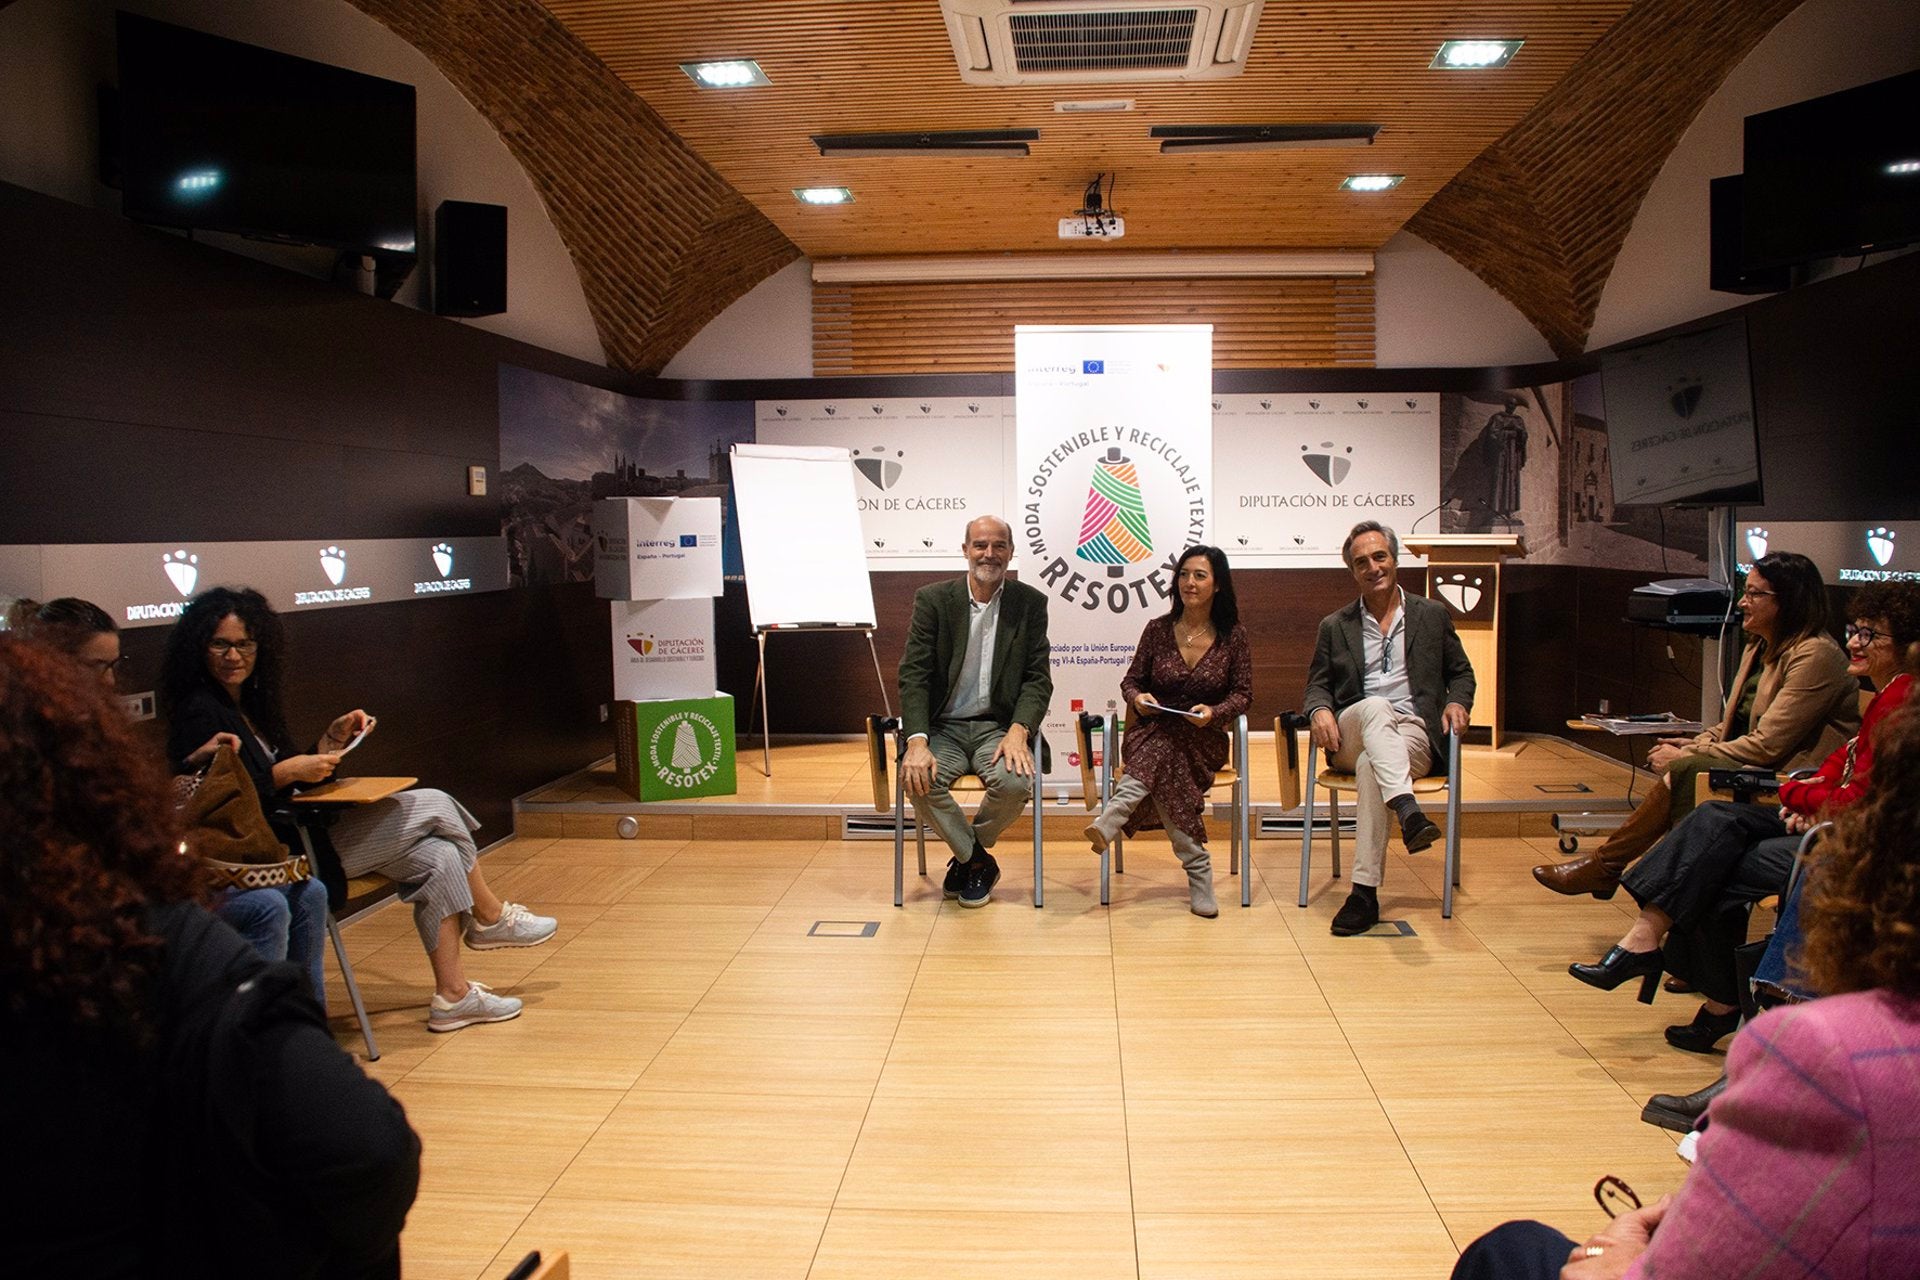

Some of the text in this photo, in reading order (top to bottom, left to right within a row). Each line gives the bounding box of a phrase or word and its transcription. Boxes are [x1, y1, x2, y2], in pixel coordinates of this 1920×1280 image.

[1115, 426, 1124, 440] Y
[1028, 426, 1109, 498] SOSTENIBLE
[1129, 427, 1200, 495] RECICLAJE
[884, 498, 900, 511] DE
[905, 495, 967, 511] CÁCERES
[1239, 492, 1415, 508] DIPUTACIÓN DE CÁCERES
[1025, 501, 1047, 556] MODA
[658, 647, 668, 655] DE
[1049, 643, 1071, 652] nciado
[1071, 644, 1082, 653] por
[1110, 643, 1136, 653] Europea
[650, 712, 683, 744] SOSTENIBLE
[684, 711, 689, 719] Y
[689, 712, 720, 738] RECICLAJE
[712, 738, 722, 761] TEXTIL
[656, 761, 719, 788] RESOTEX
